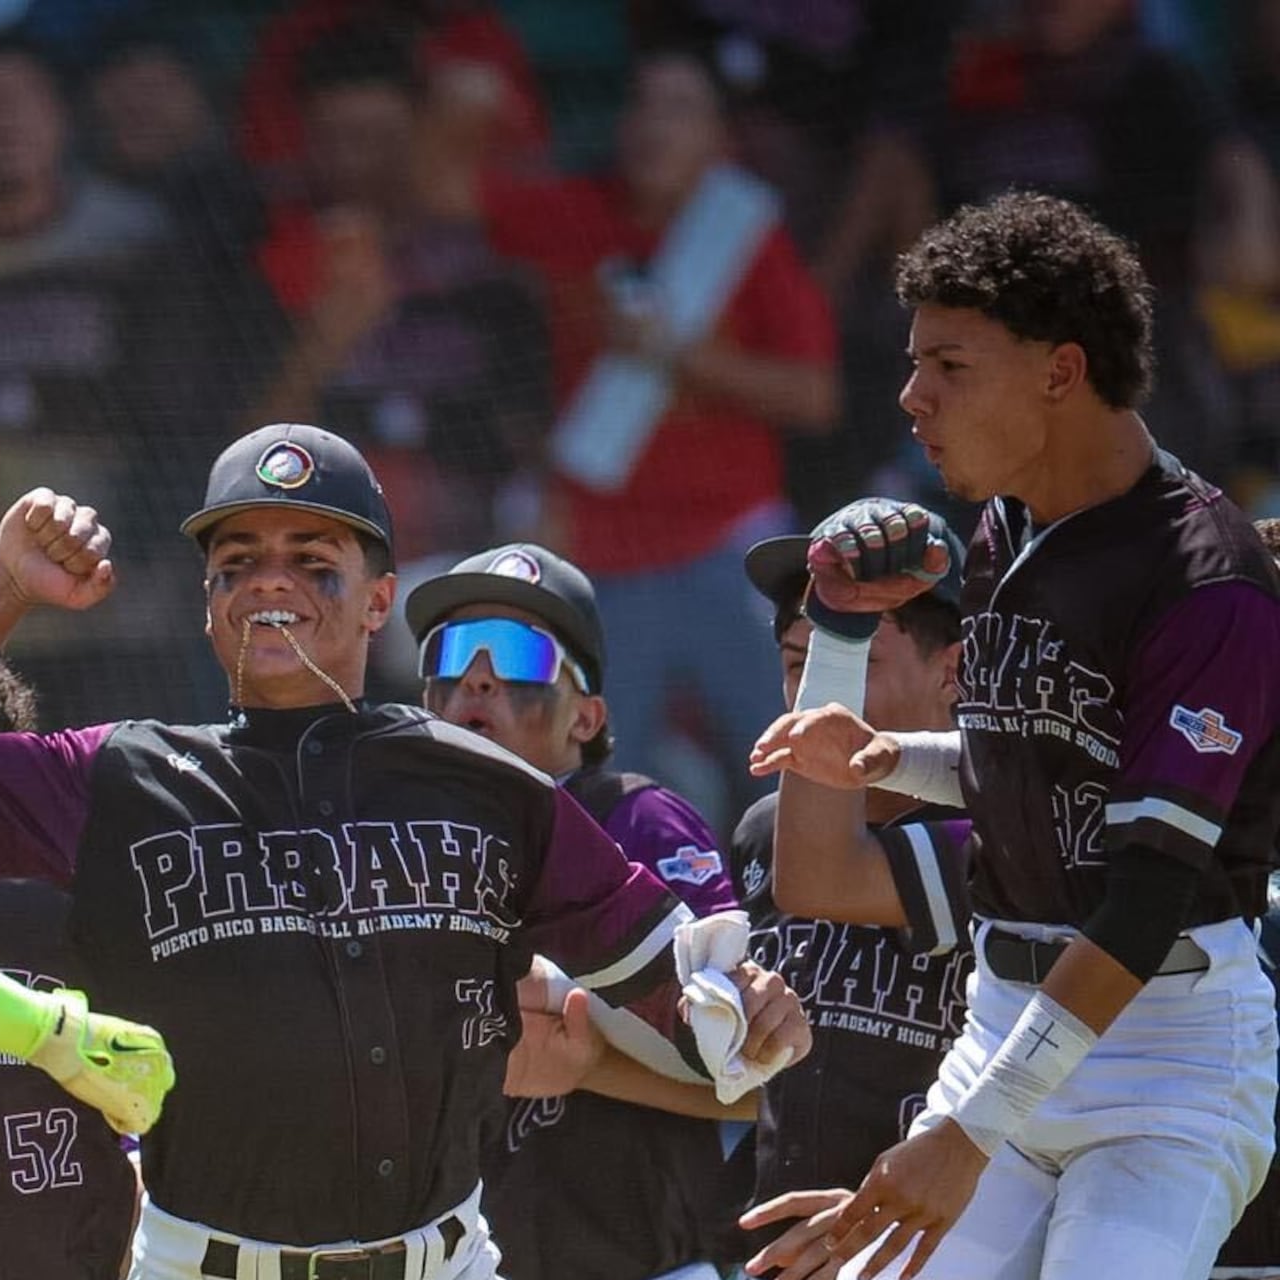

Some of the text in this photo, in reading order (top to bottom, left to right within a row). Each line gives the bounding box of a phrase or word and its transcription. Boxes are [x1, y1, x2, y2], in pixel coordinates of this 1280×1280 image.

[1033, 719, 1071, 742] HIGH
[130, 820, 522, 939] PRBAHS
[151, 926, 209, 963] PUERTO
[213, 917, 255, 941] RICO
[896, 1025, 946, 1049] HIGH
[4, 1107, 83, 1194] 52
